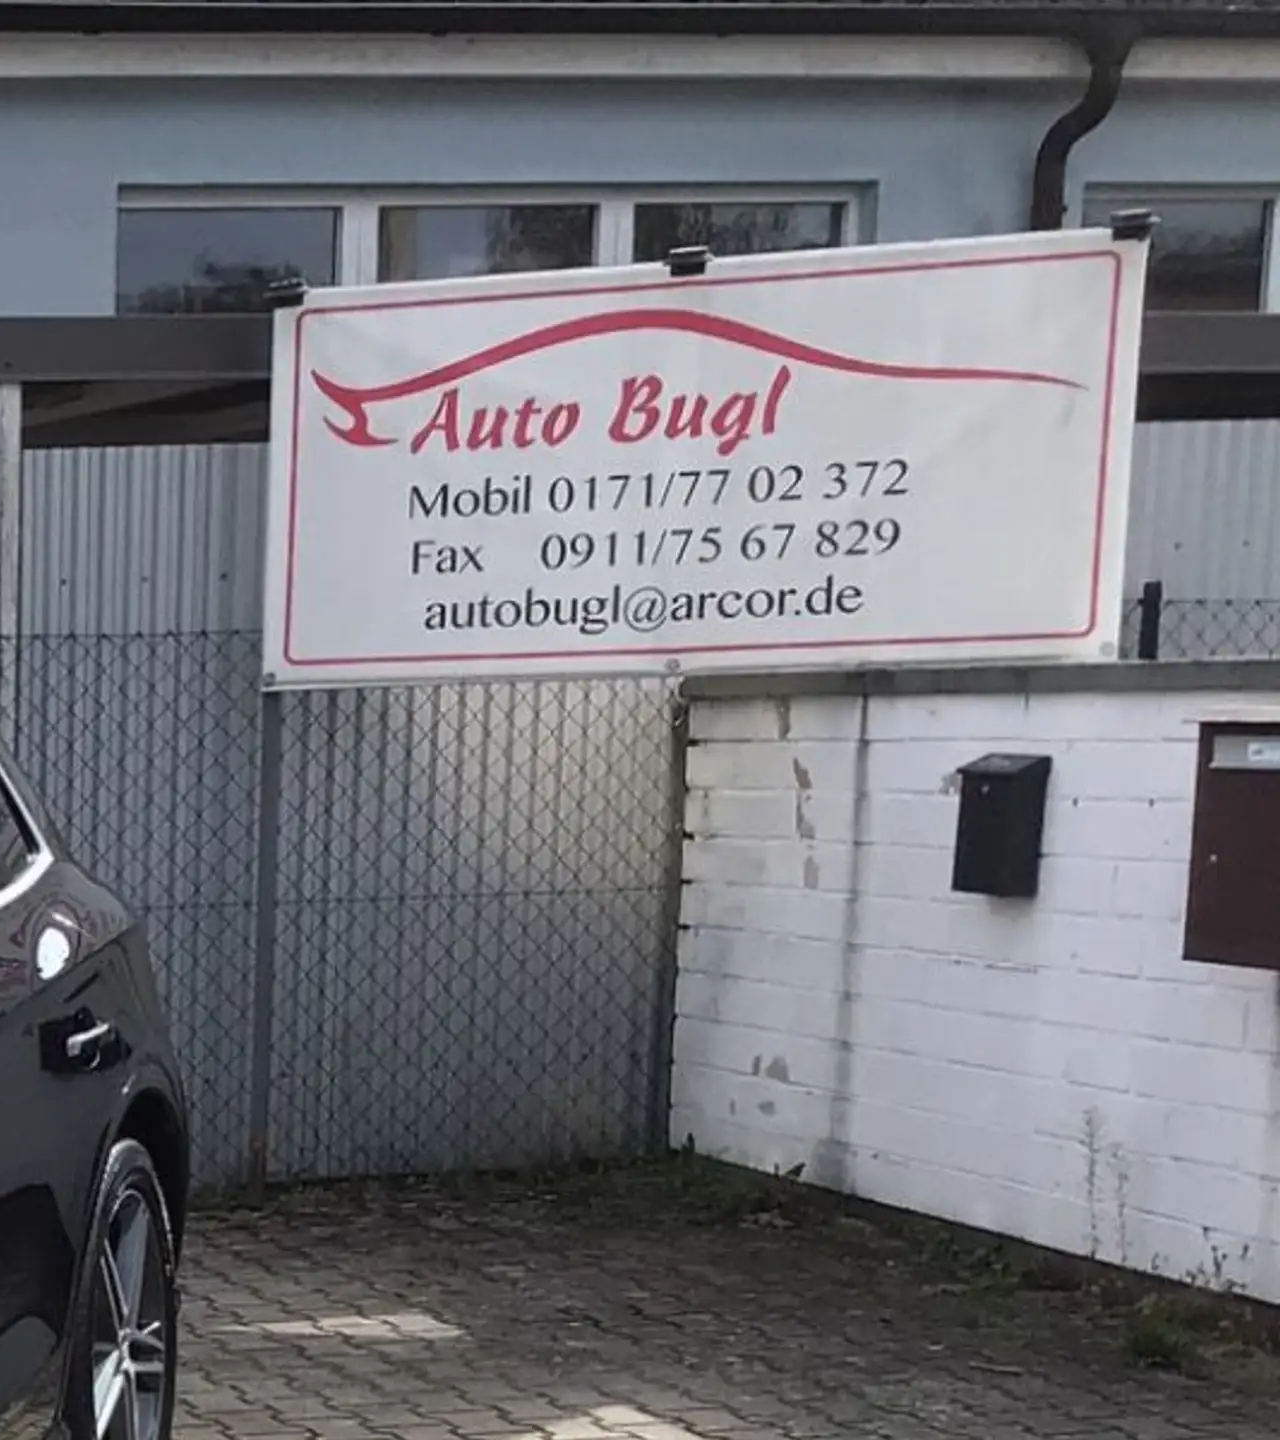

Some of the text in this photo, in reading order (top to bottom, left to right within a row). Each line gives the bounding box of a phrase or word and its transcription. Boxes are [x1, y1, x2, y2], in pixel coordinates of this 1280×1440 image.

[410, 364, 792, 458] Auto Bugl
[408, 459, 910, 520] Mobil 0171/77 02 372
[410, 517, 903, 575] Fax 0911/75 67 829
[424, 574, 865, 636] autobugl@arcor.de
